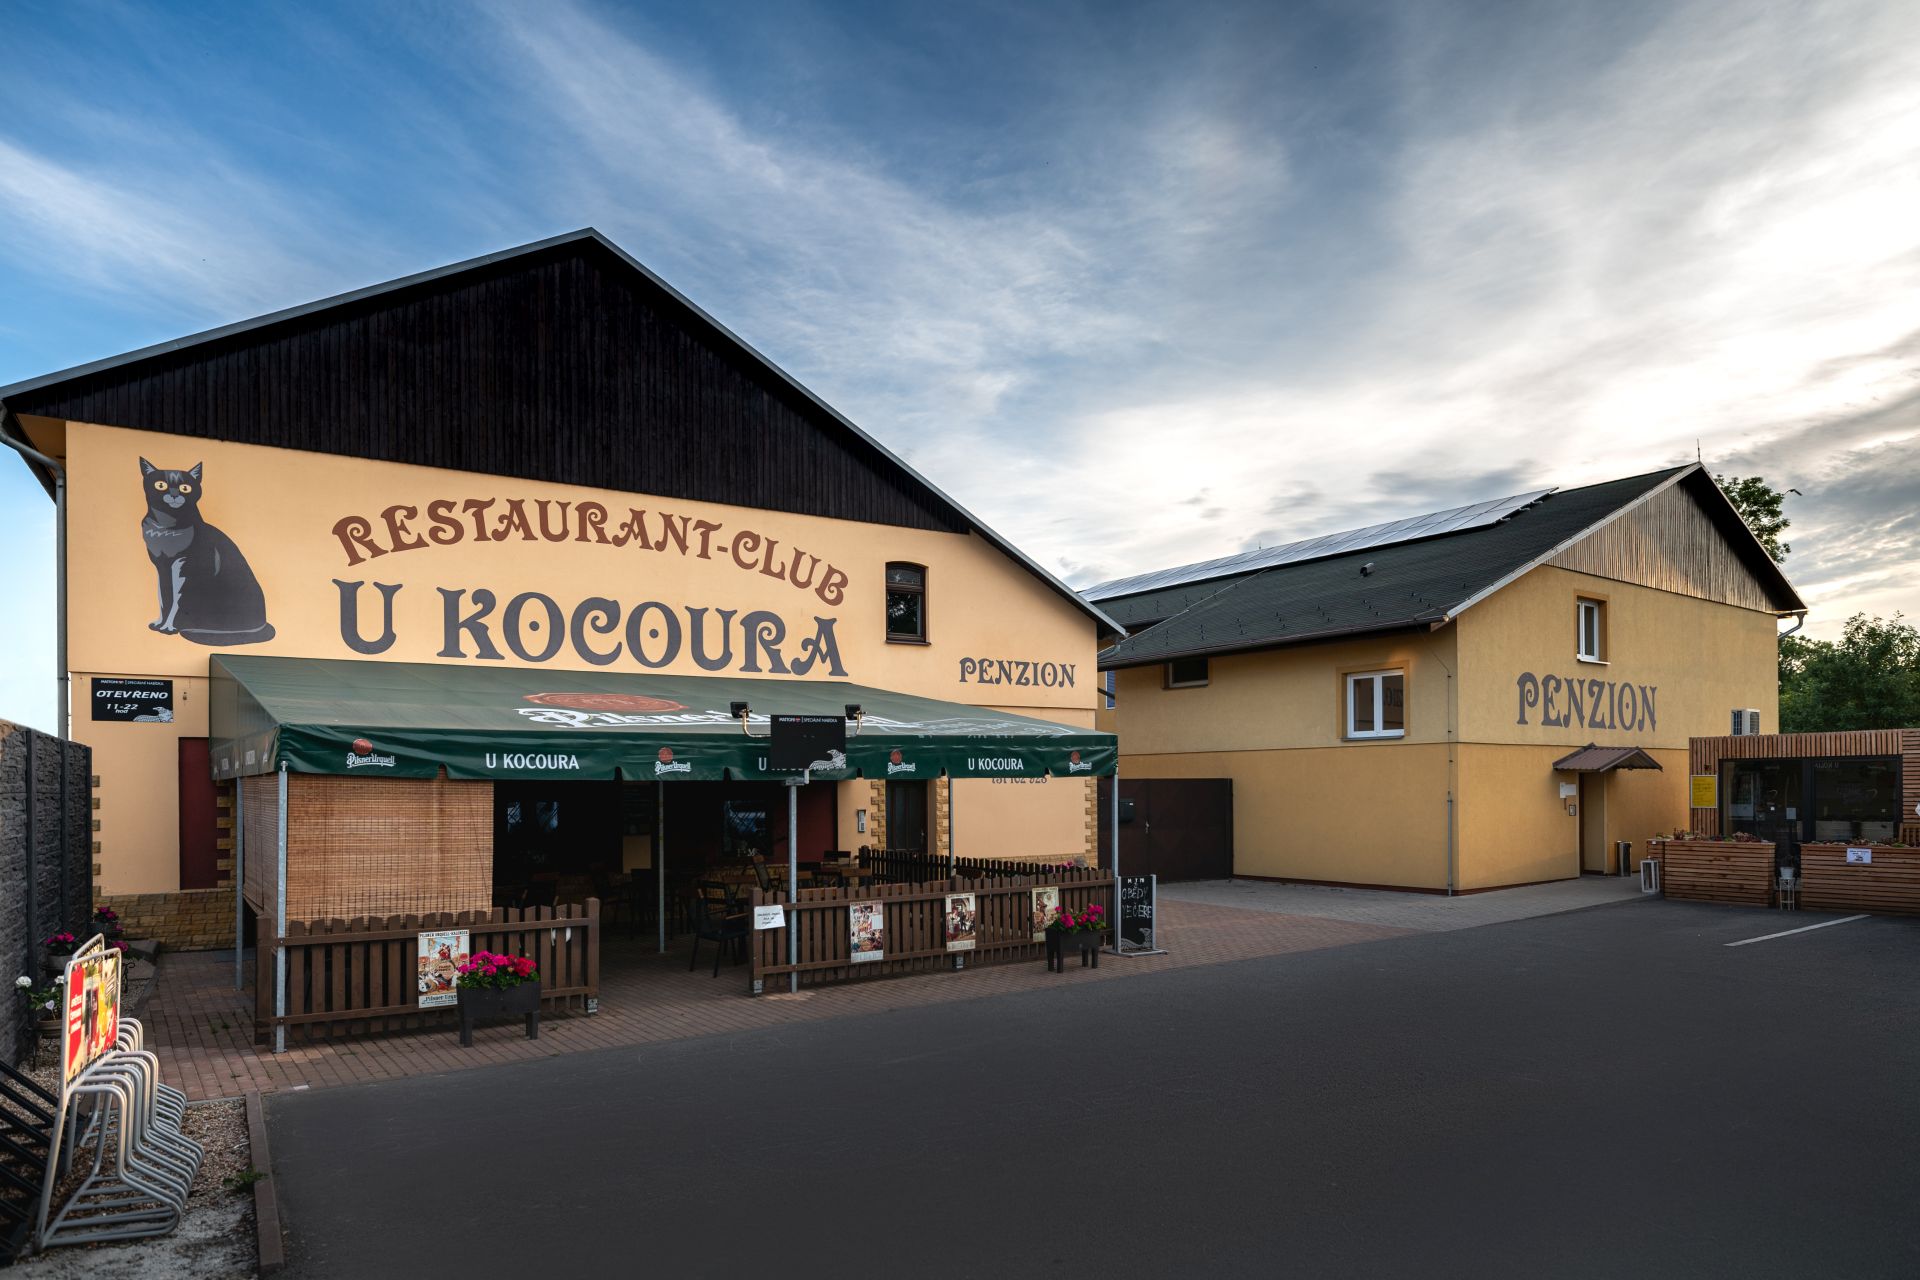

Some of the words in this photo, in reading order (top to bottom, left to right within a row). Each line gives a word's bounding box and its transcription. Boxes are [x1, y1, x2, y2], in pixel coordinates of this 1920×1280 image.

[332, 497, 849, 606] RESTAURANT-CLUB
[332, 578, 403, 655] U
[437, 586, 849, 677] KOCOURA
[959, 657, 1076, 688] PENZION
[96, 690, 169, 699] OTEVŘENO
[1517, 672, 1658, 732] PENZION
[346, 752, 373, 769] Pilsner
[371, 752, 396, 767] Urquell
[485, 753, 497, 769] U
[503, 753, 580, 770] KOCOURA
[968, 758, 975, 770] U
[978, 758, 1024, 771] KOCOURA
